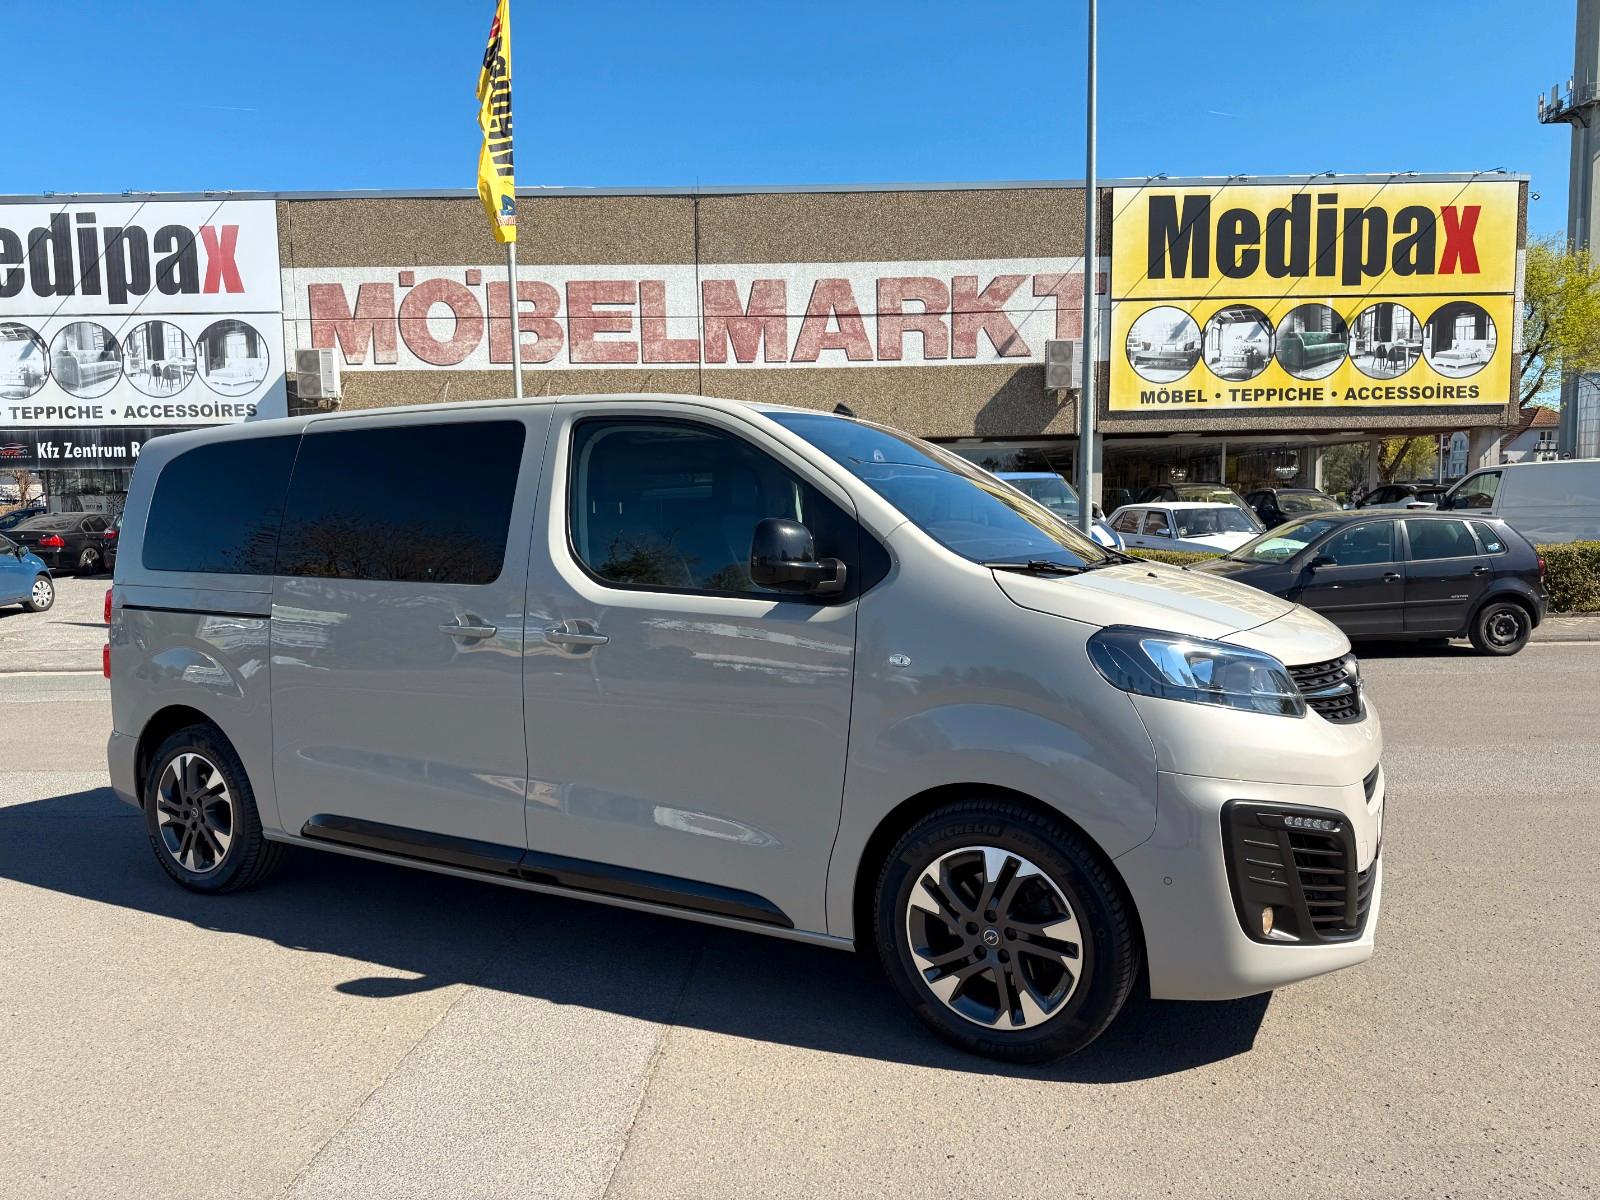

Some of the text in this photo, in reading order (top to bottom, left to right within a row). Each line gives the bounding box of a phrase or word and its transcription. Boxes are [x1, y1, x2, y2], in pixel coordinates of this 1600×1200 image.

[1147, 193, 1482, 286] Medipax
[1140, 385, 1207, 405] MÖBEL
[1229, 388, 1324, 402] TEPPICHE
[8, 405, 104, 420] TEPPICHE
[37, 441, 60, 459] Kfz
[63, 442, 127, 458] Zentrum
